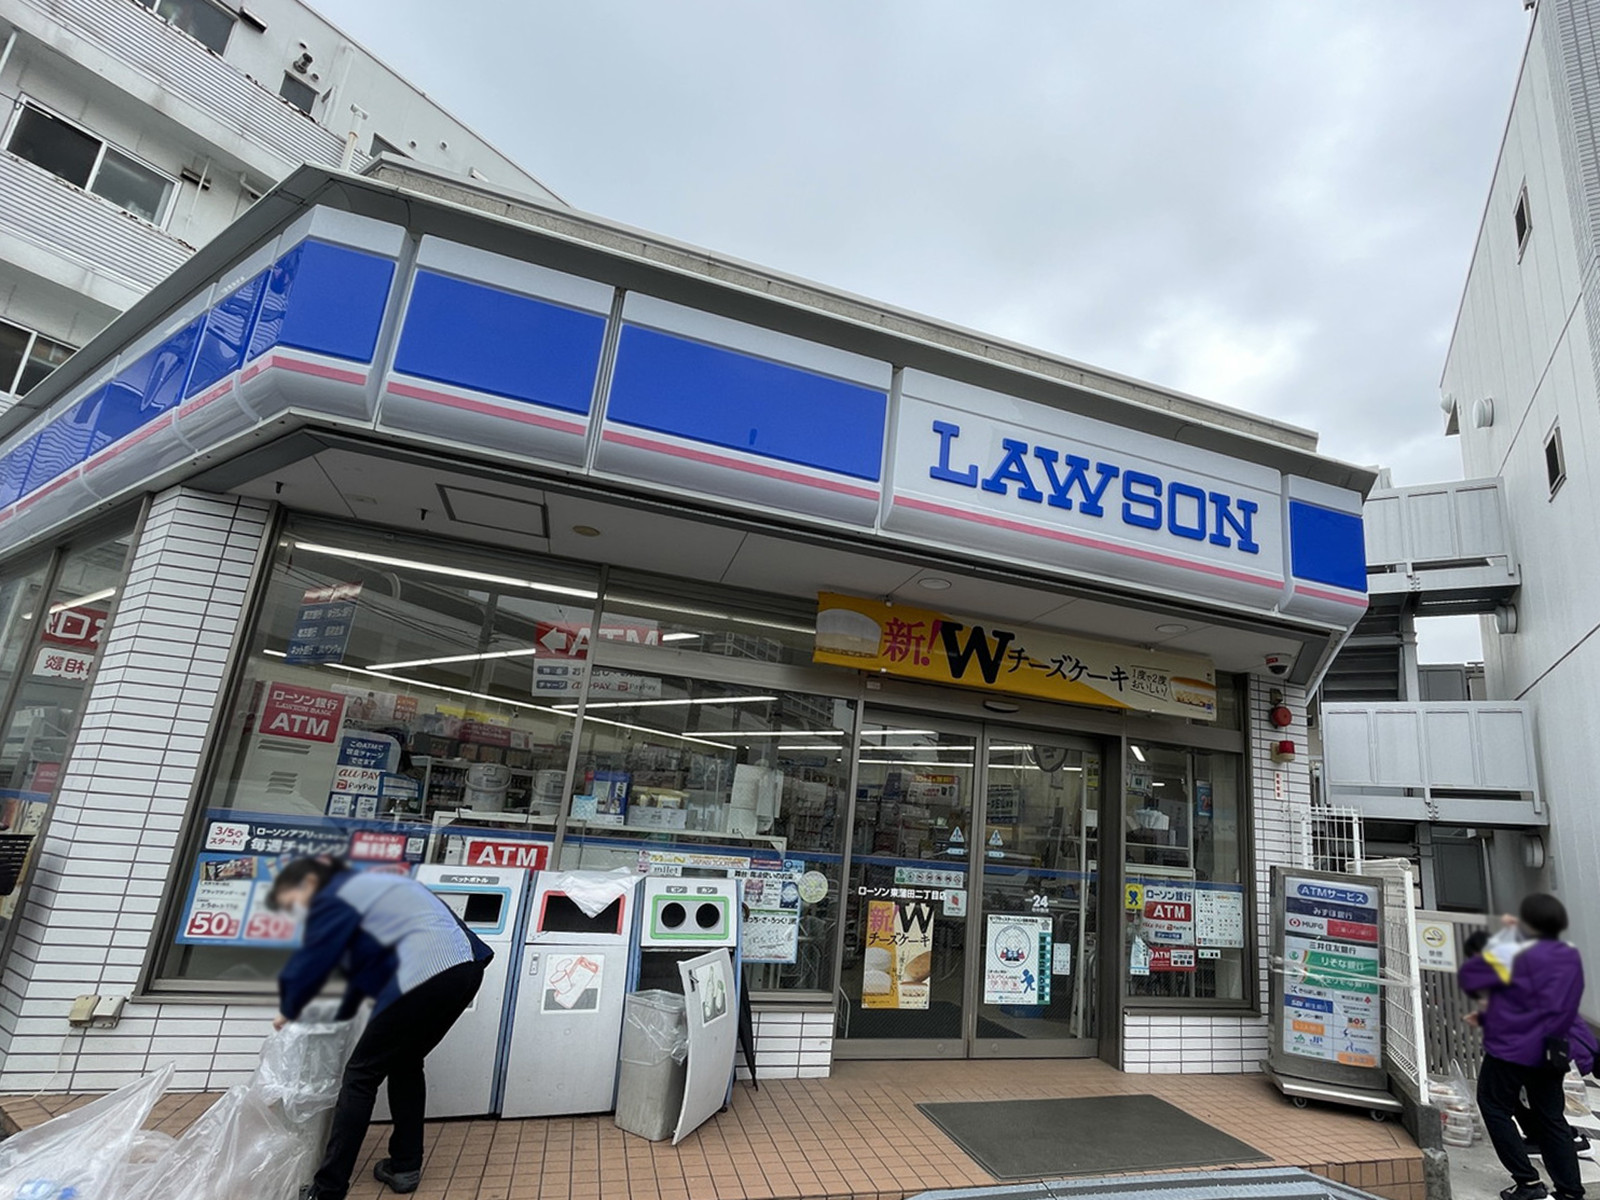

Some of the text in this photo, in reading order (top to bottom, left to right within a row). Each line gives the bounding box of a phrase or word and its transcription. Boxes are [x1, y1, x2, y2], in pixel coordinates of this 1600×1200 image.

[930, 420, 1259, 554] LAWSON
[940, 621, 1015, 684] W
[1007, 648, 1130, 693] チーズケーキ
[273, 691, 338, 711] ローソン銀行
[269, 712, 330, 736] ATM
[350, 740, 384, 750] このATMで
[351, 757, 376, 766] できます
[361, 771, 380, 780] PAY
[348, 782, 377, 791] PayPay
[251, 838, 348, 857] 毎週チャレンジ
[476, 846, 538, 867] ATM
[451, 876, 489, 884] ペットボトル
[858, 886, 890, 897] ローソン
[1146, 889, 1192, 902] ローソン銀行
[1301, 886, 1365, 903] ATMサービス
[1033, 894, 1048, 908] 24
[898, 901, 935, 934] W
[1153, 904, 1185, 919] ATM
[1313, 907, 1353, 920] みずほ銀行
[1302, 921, 1324, 930] MUFG
[868, 931, 930, 947] チーズケーキ
[1154, 951, 1170, 959] ATM
[1309, 941, 1356, 955] 三井住友銀行
[1321, 956, 1365, 970] りそな銀行
